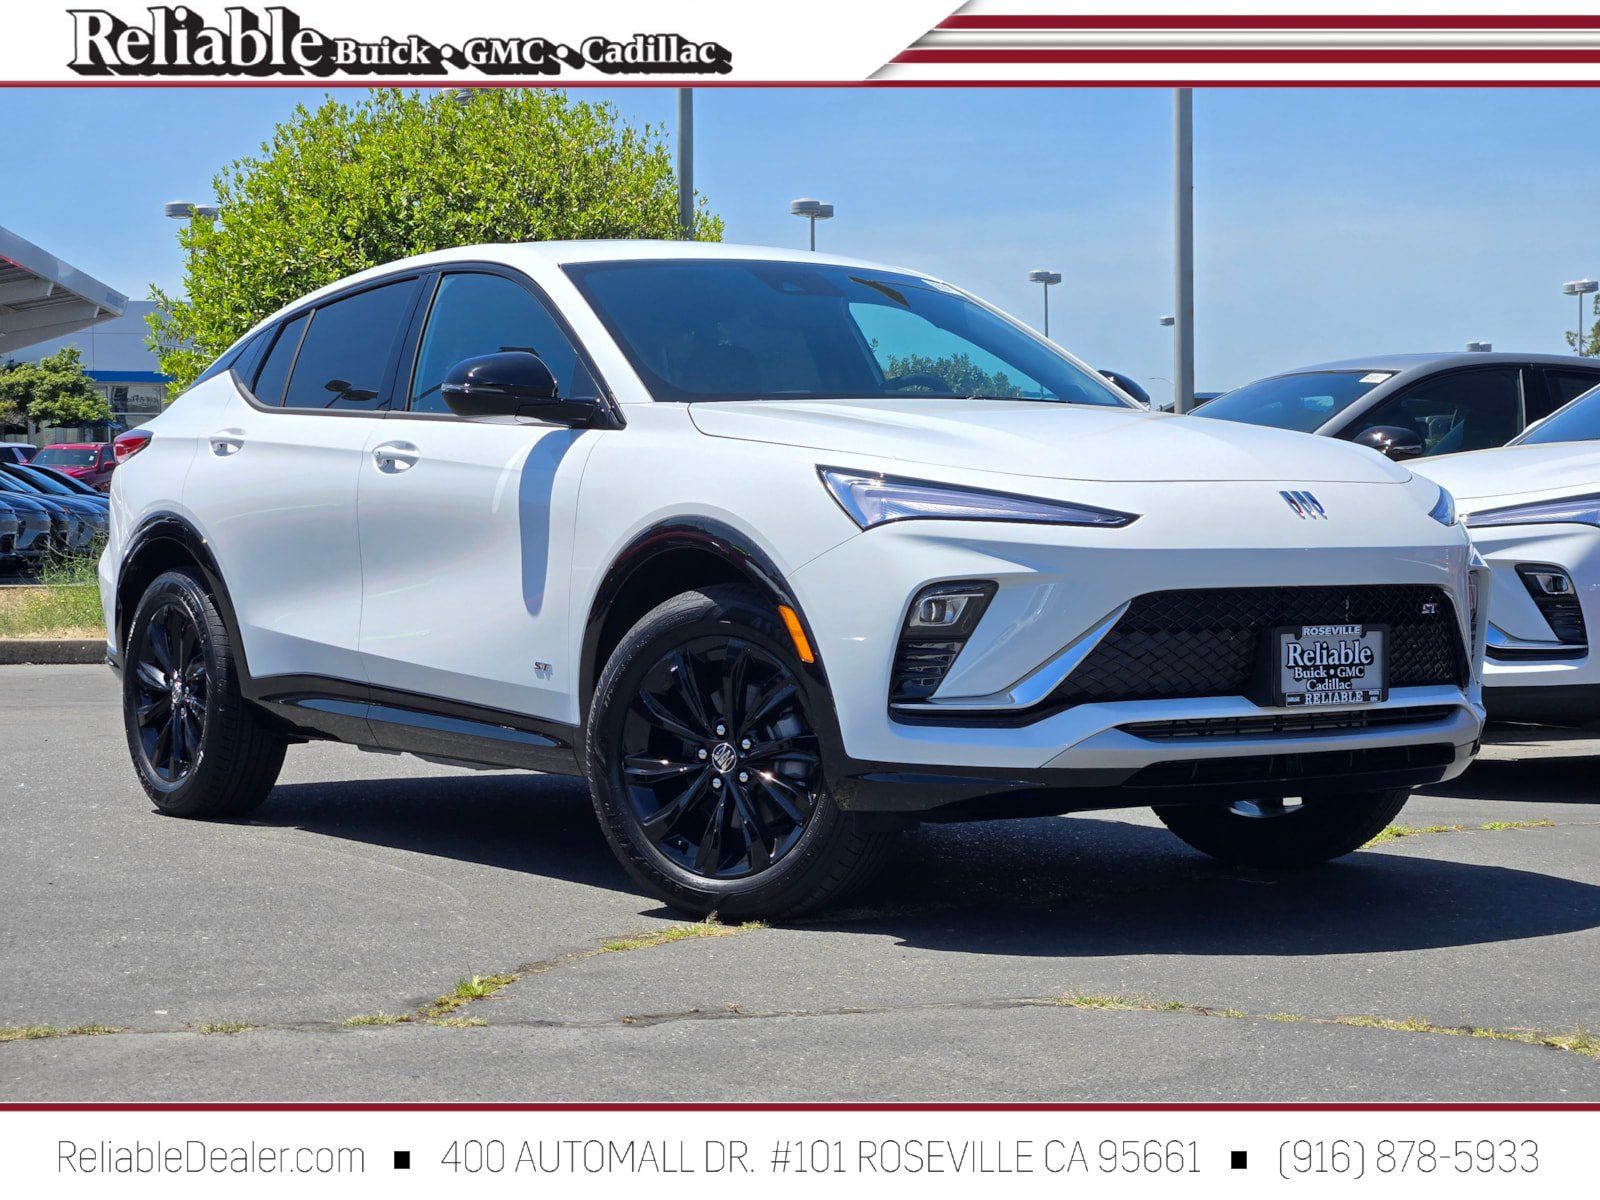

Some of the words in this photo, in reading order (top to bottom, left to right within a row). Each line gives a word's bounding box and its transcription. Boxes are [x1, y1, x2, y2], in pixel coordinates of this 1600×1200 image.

[1302, 626, 1361, 636] ROSEVILLE
[1286, 640, 1374, 667] Reliable
[1294, 667, 1328, 679] Buick
[1337, 667, 1365, 677] GMC
[1306, 679, 1351, 691] Cadillac
[1305, 691, 1363, 705] RELIABLE
